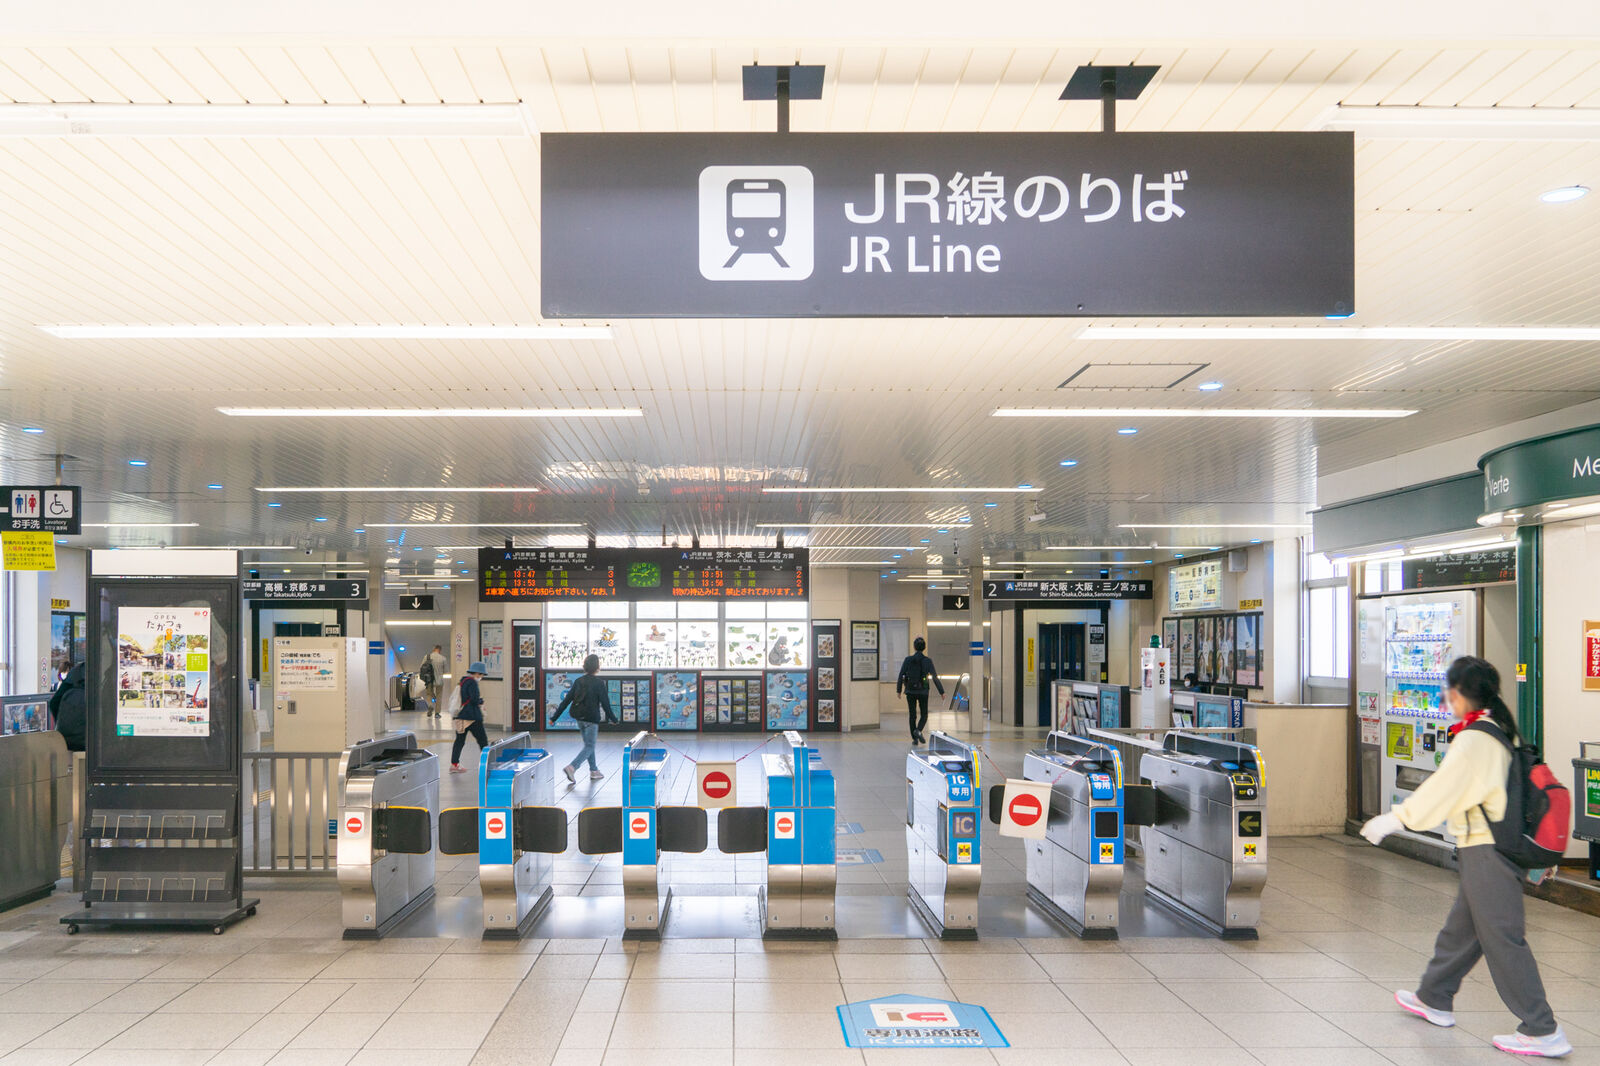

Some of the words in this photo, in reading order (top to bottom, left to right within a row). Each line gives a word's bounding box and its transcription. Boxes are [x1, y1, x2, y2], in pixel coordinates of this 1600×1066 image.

[844, 170, 1189, 225] JR線のりば
[842, 236, 892, 273] JR
[908, 235, 1001, 273] Line
[12, 519, 40, 529] お手洗
[513, 570, 535, 578] 13:47
[608, 570, 614, 578] 3
[702, 570, 723, 578] 13:51
[796, 570, 802, 578] 2
[264, 583, 308, 592] 高槻・京都
[310, 584, 326, 592] 方面
[513, 579, 535, 587] 13:53
[608, 579, 614, 587] 3
[796, 579, 802, 587] 2
[1040, 582, 1129, 592] 新大阪・大阪・三ノ宮
[1130, 584, 1146, 592] 方面
[350, 583, 360, 597] 3
[988, 583, 997, 597] 2
[146, 620, 182, 632] たかつき
[952, 775, 966, 784] IC
[951, 787, 969, 797] 専用
[955, 816, 973, 834] IC
[863, 1028, 980, 1038] 専用通路
[940, 1038, 984, 1046] Only
